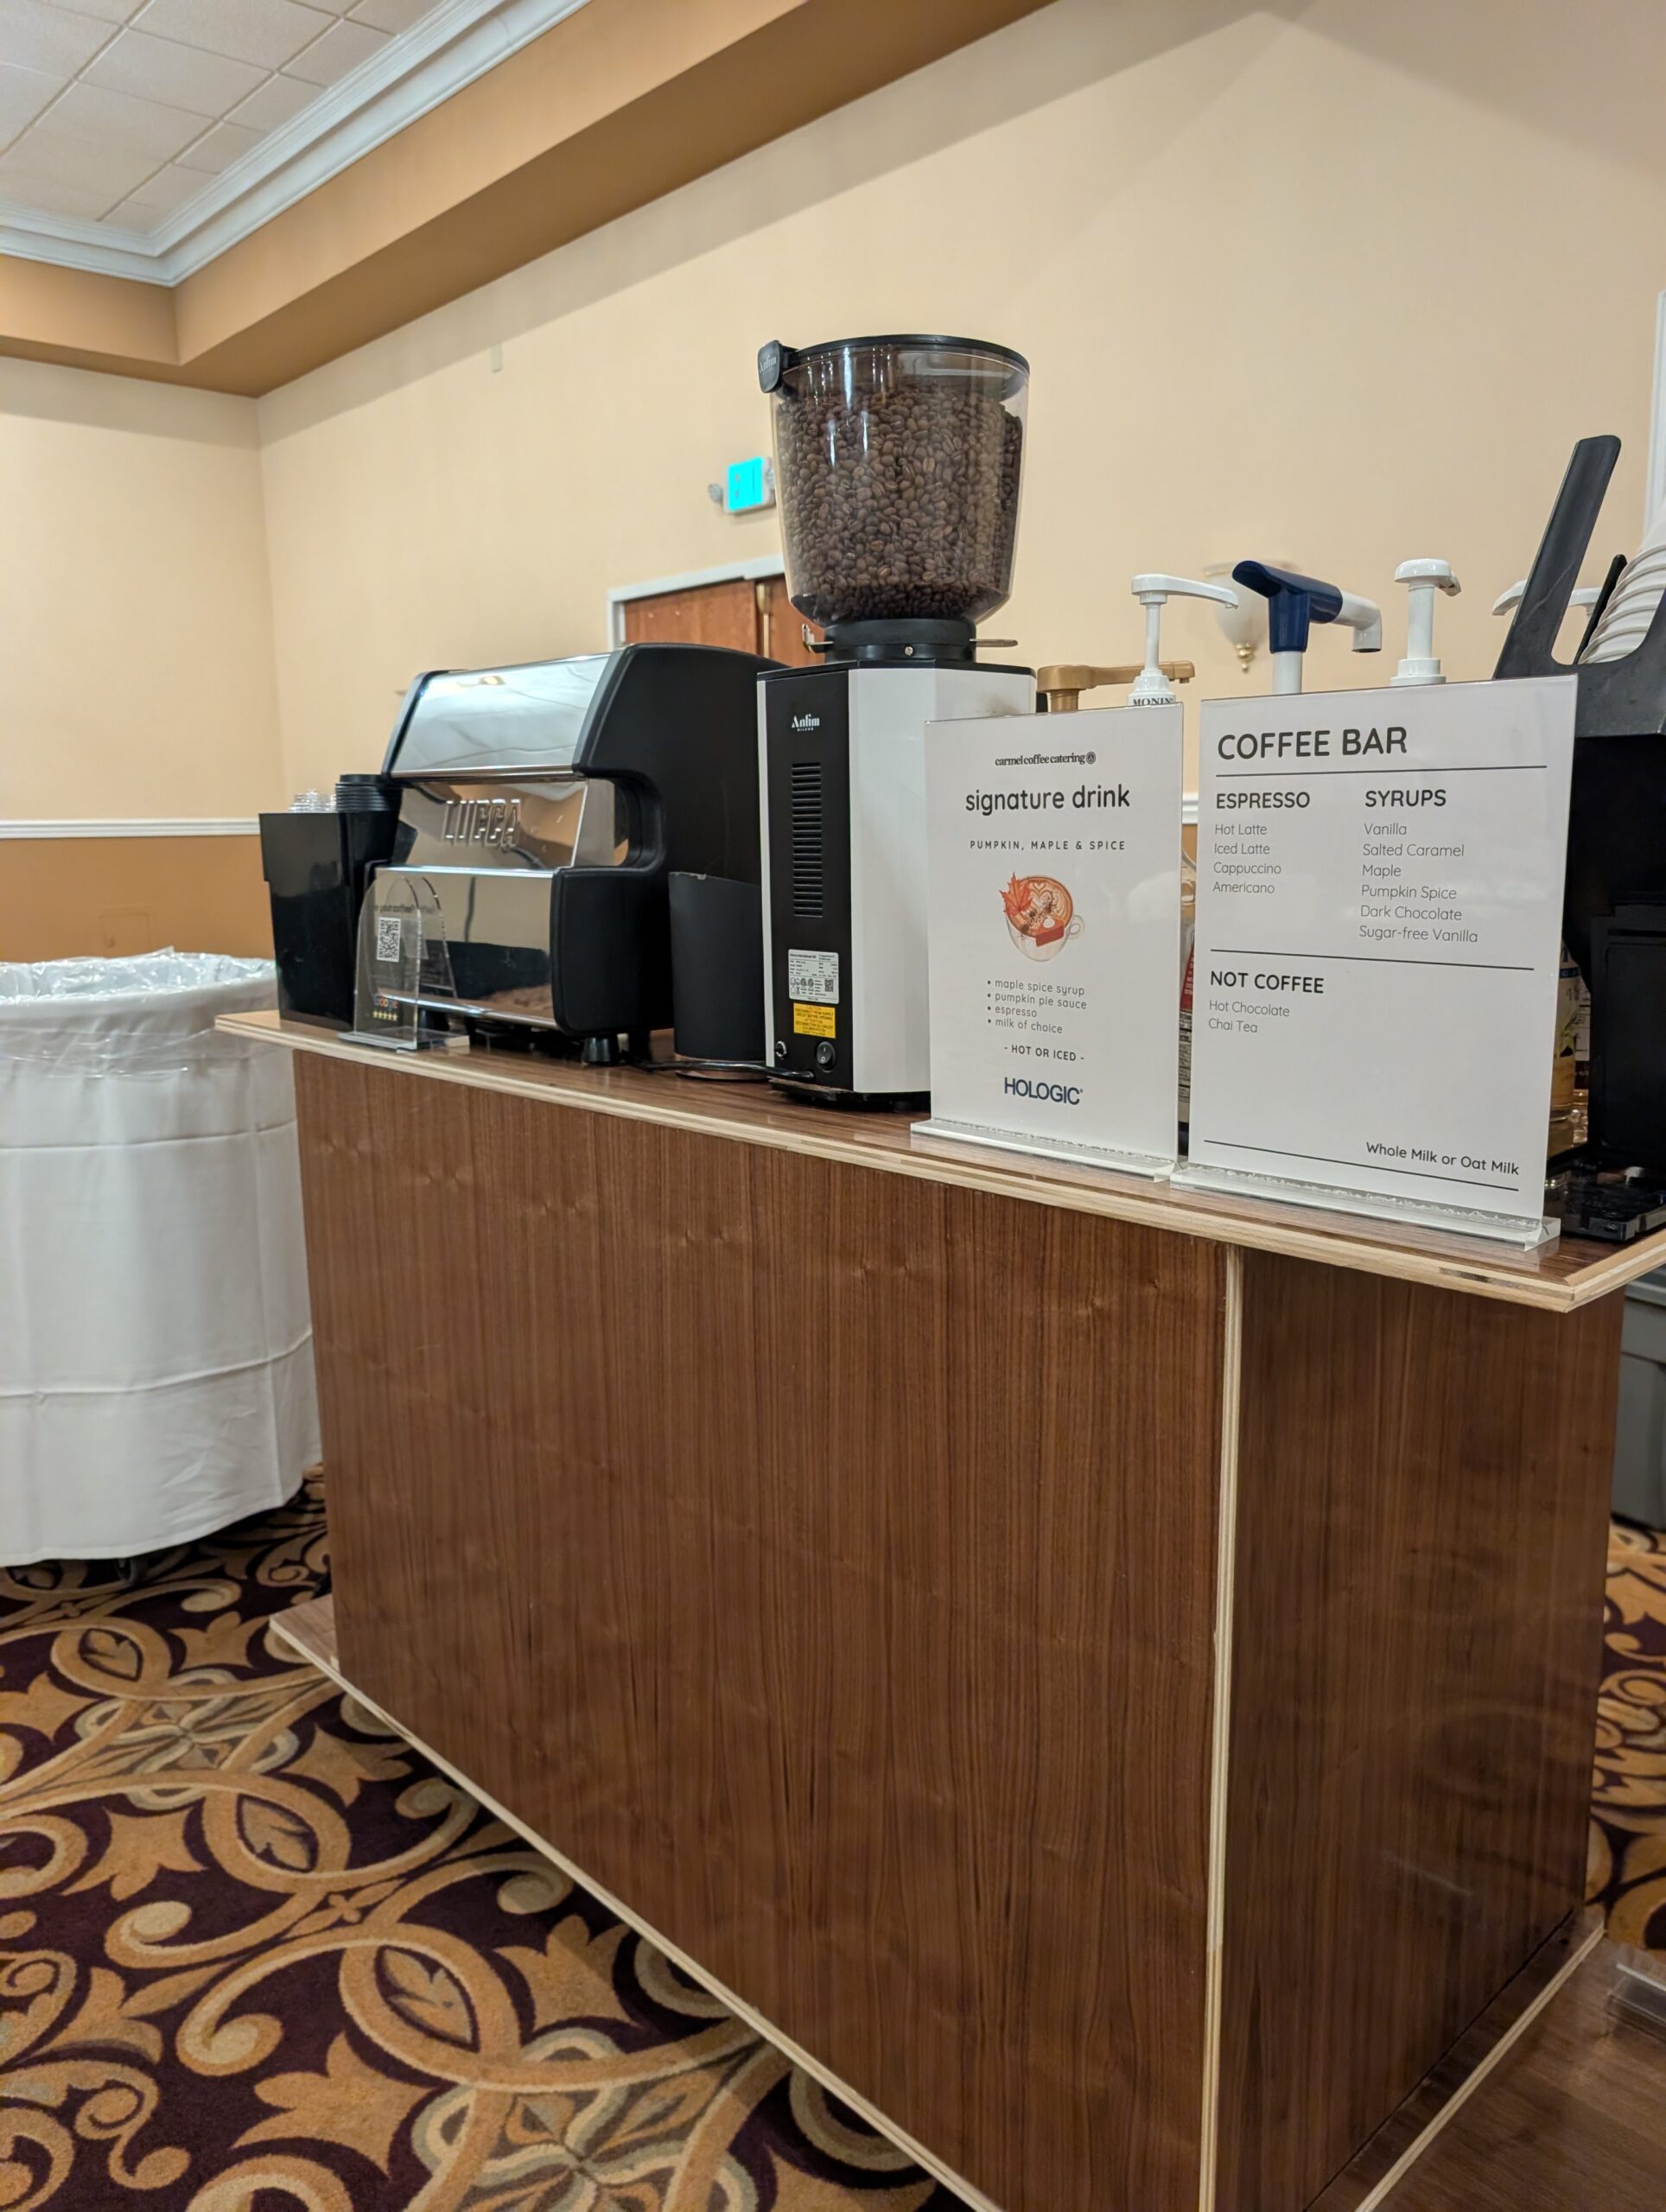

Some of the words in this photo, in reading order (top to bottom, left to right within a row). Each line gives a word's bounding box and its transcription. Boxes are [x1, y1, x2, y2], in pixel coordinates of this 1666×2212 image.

[792, 714, 820, 728] Anfim
[1218, 729, 1331, 760] COFFEE
[1341, 726, 1408, 756] BAR
[995, 755, 1023, 766] carmel
[1023, 753, 1050, 765] coffee
[1050, 752, 1085, 766] catering
[965, 789, 1065, 817] signature
[1071, 783, 1130, 809] drink
[1216, 791, 1311, 809] ESPRESSO
[1364, 788, 1447, 808] SYRUPS
[1214, 823, 1237, 836] Hot
[1237, 823, 1268, 836] Latte
[1363, 823, 1408, 836] Vanilla
[970, 840, 1025, 850] PUMPKIN,
[1031, 840, 1069, 850] MAPLE
[1075, 840, 1083, 850] &
[1089, 840, 1125, 850] SPICE
[1213, 842, 1238, 855] Iced
[1241, 842, 1271, 855] Latte
[1362, 842, 1403, 856] Salted
[1406, 843, 1465, 857] Caramel
[1212, 861, 1281, 876] Cappuccino
[1361, 864, 1402, 879] Maple
[1212, 880, 1275, 893] Americano
[1361, 884, 1417, 899] Pumpkin
[1420, 886, 1458, 901] Spice
[1360, 905, 1391, 918] Dark
[1394, 905, 1463, 921] Chocolate
[1358, 925, 1429, 941] Sugar-free
[1431, 928, 1478, 944] Vanilla
[995, 980, 1024, 990] maple
[1027, 982, 1053, 993] spice
[1056, 985, 1085, 998] syrup
[1210, 970, 1249, 988] NOT
[1254, 974, 1325, 994] COFFEE
[995, 992, 1035, 1004] pumpkin
[1039, 996, 1054, 1007] pie
[1057, 999, 1087, 1009] sauce
[995, 1006, 1038, 1018] espresso
[1209, 1000, 1230, 1012] Hot
[1231, 1001, 1290, 1017] Chocolate
[995, 1018, 1014, 1028] milk
[1018, 1020, 1027, 1029] of
[1031, 1021, 1063, 1033] choice
[1208, 1018, 1233, 1031] Chai
[1236, 1020, 1258, 1033] Tea
[1011, 1044, 1032, 1055] HOT
[1035, 1047, 1050, 1058] OR
[1052, 1050, 1077, 1061] ICED
[1366, 1141, 1408, 1159] Whole
[1411, 1147, 1438, 1163] Milk
[1441, 1155, 1457, 1165] or
[1460, 1155, 1487, 1171] Oat
[1491, 1160, 1519, 1175] Milk
